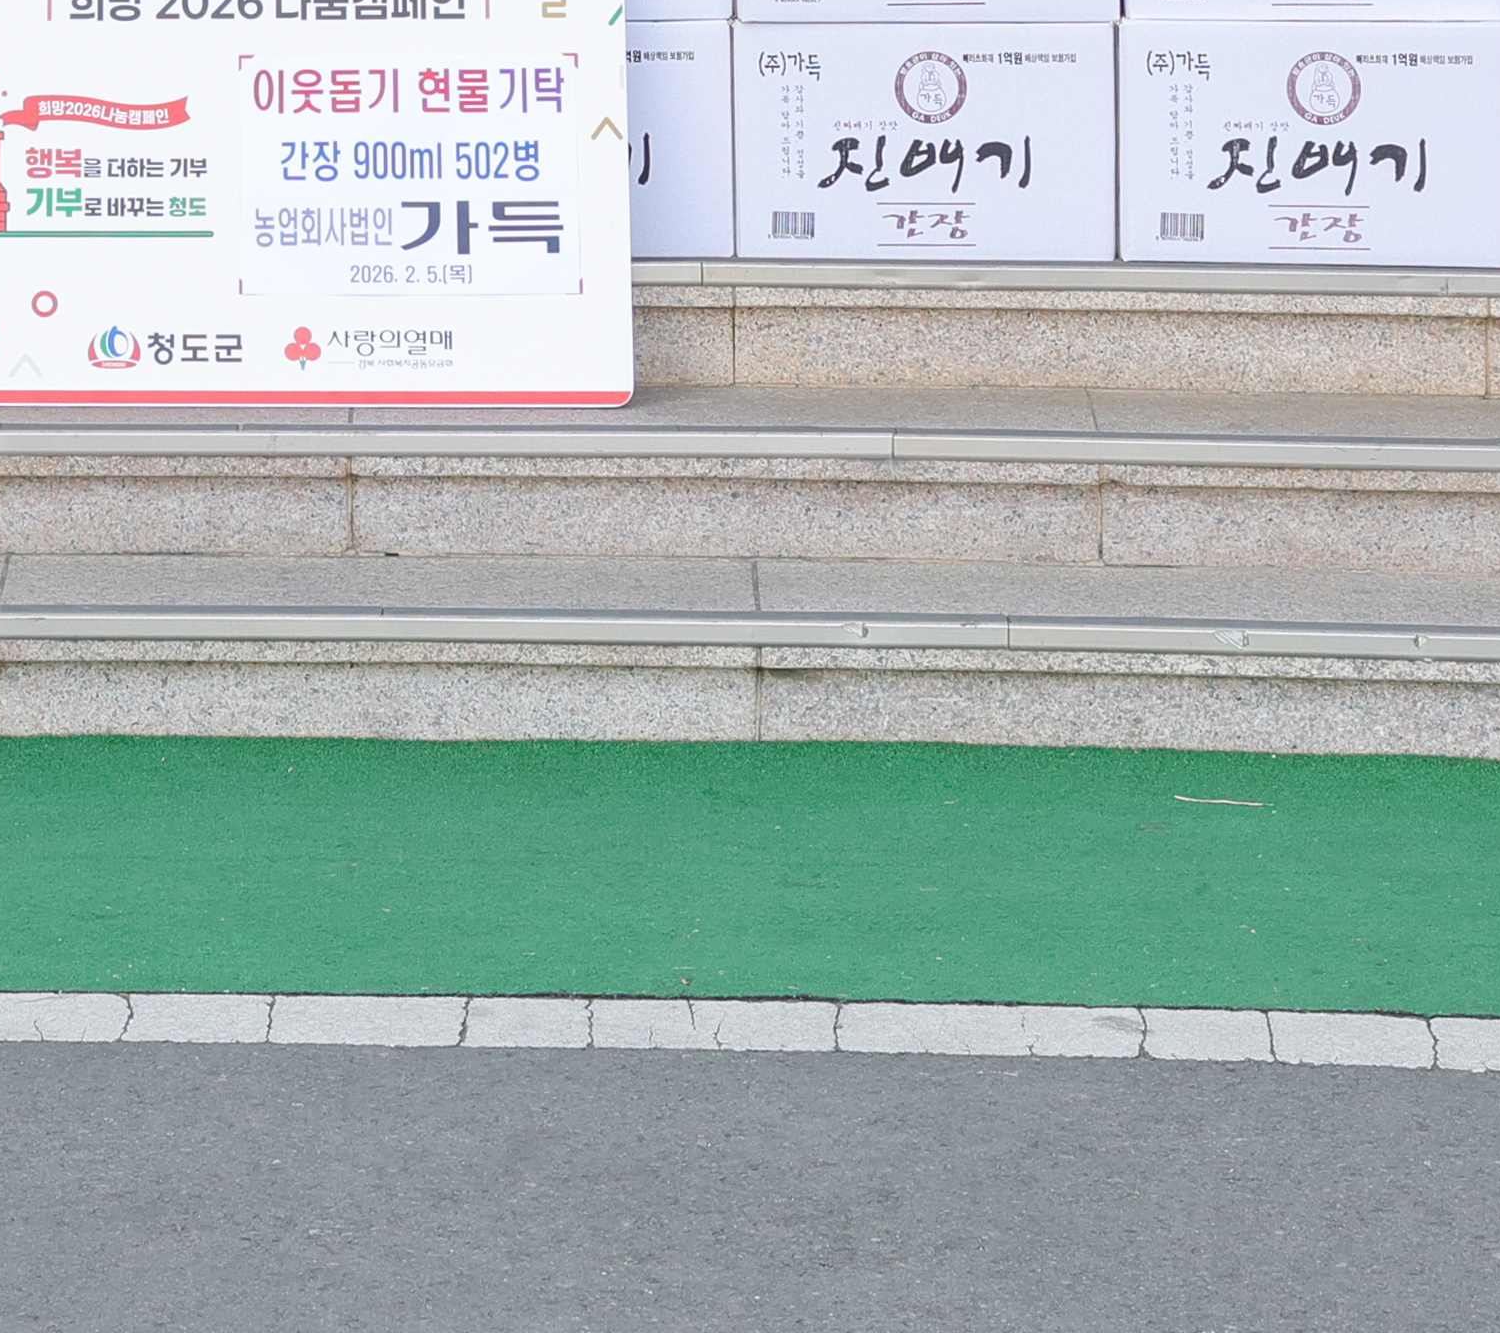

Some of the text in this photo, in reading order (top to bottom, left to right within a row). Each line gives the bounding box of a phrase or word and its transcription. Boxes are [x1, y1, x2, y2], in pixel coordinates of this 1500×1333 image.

[758, 50, 822, 82] (주)가득
[1146, 49, 1211, 81] (주)가득
[1392, 53, 1418, 66] 1억원
[253, 67, 402, 116] 이웃돕기
[37, 100, 170, 125] 희망2026나눔캠페인
[25, 147, 208, 179] 행복을 더하는 기부
[280, 138, 541, 183] 간장 900ml 502병
[819, 134, 1036, 198] 진배기
[1208, 134, 1426, 197] 진배기
[26, 187, 207, 218] 기부로 바꾸는 청도
[254, 199, 565, 256] 농업회사법인 가득
[881, 208, 971, 240] 간장
[1271, 209, 1361, 241] 간장
[350, 264, 398, 284] 2026.
[405, 264, 420, 283] 2.
[147, 332, 243, 366] 청도군
[327, 329, 454, 357] 사랑의열매
